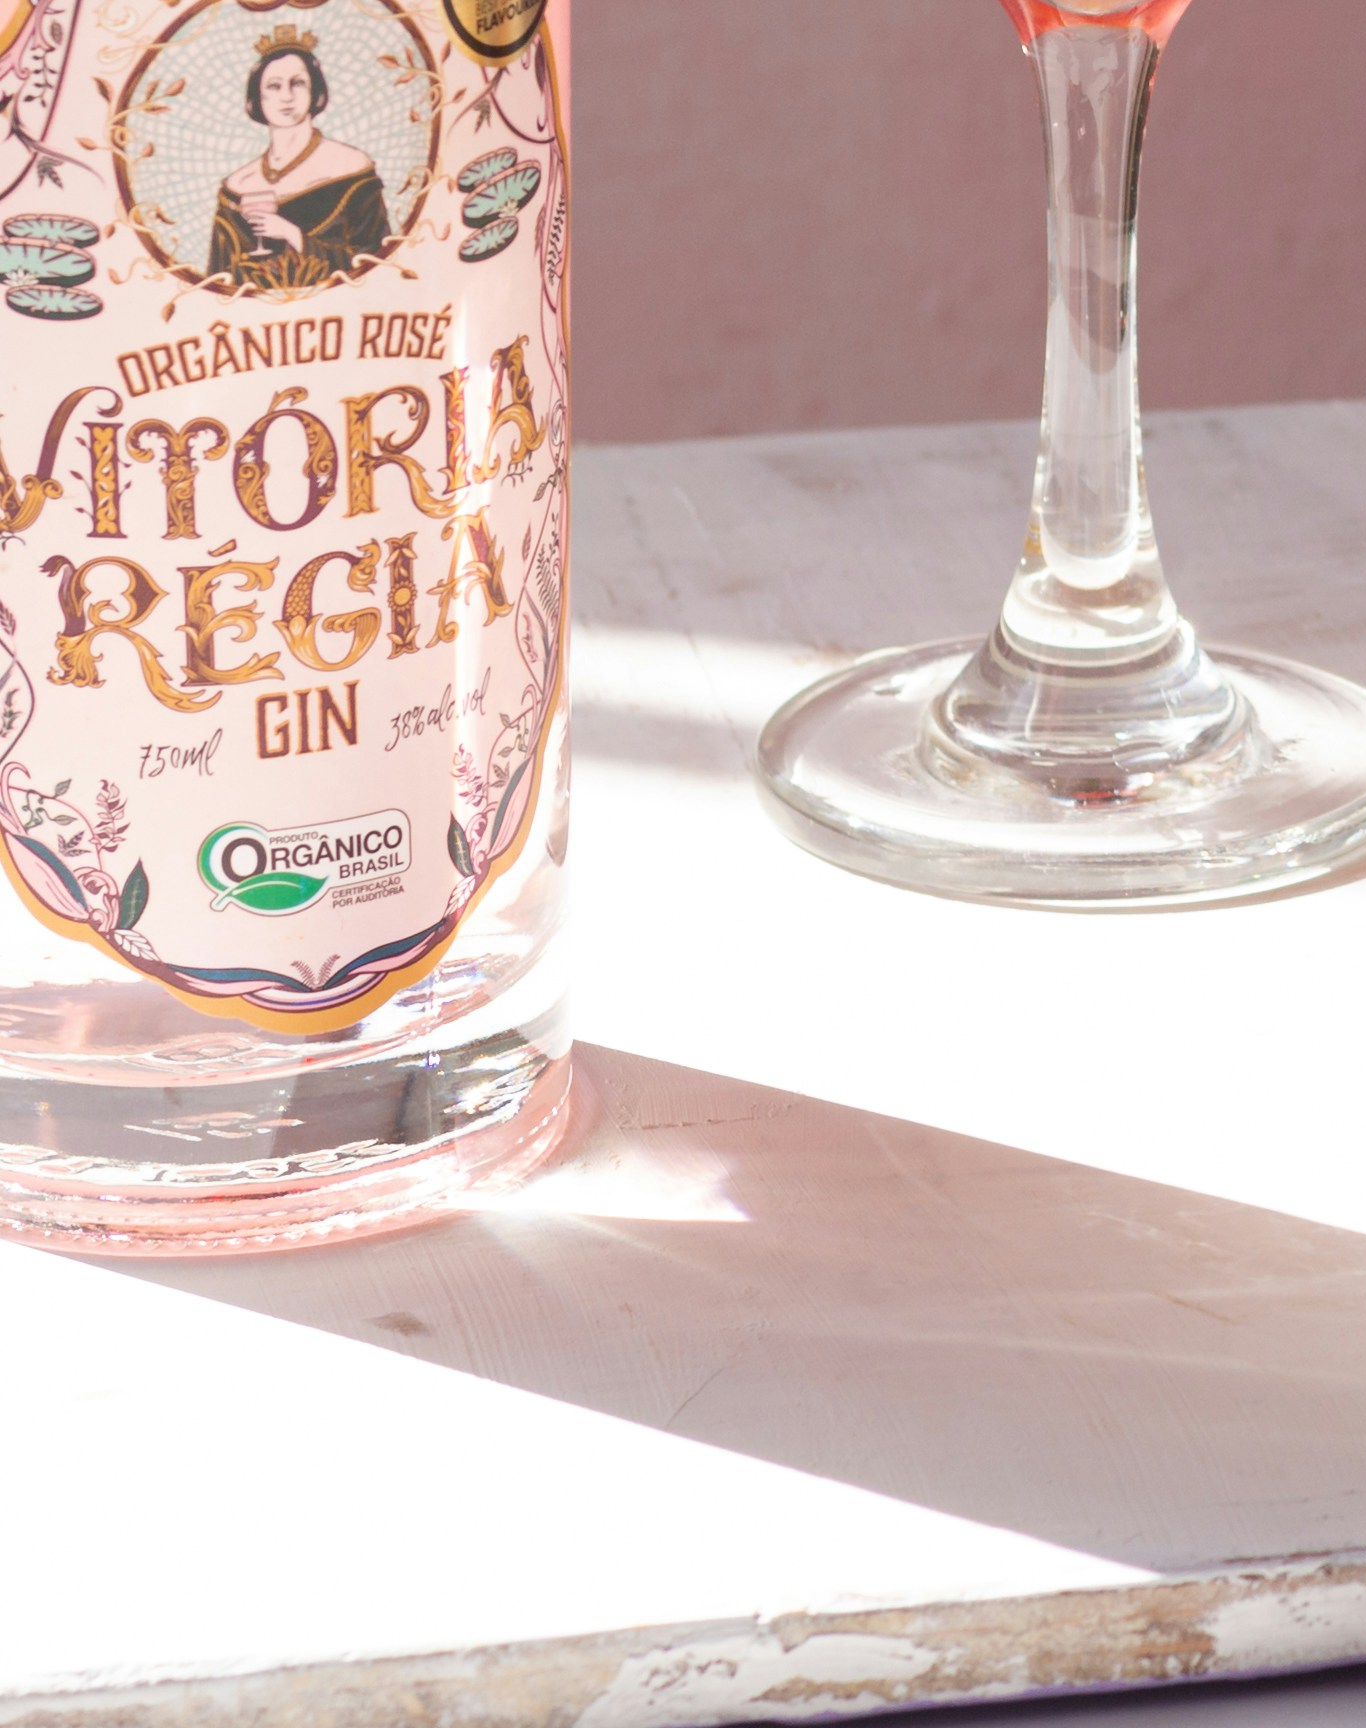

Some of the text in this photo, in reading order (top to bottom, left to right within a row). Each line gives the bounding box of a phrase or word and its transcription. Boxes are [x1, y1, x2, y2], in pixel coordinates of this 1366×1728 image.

[117, 303, 453, 398] ORGÂNICO ROSÉ
[40, 503, 514, 713] RÉGIA
[256, 679, 360, 760] GIN
[139, 728, 223, 779] 750ml
[221, 825, 404, 884] ORGÂNICO
[269, 831, 319, 845] PRODUTO
[331, 876, 401, 899] CERTIFICAÇÃO
[339, 852, 404, 879] BRASIL
[332, 886, 404, 909] POR AUDITORIA
